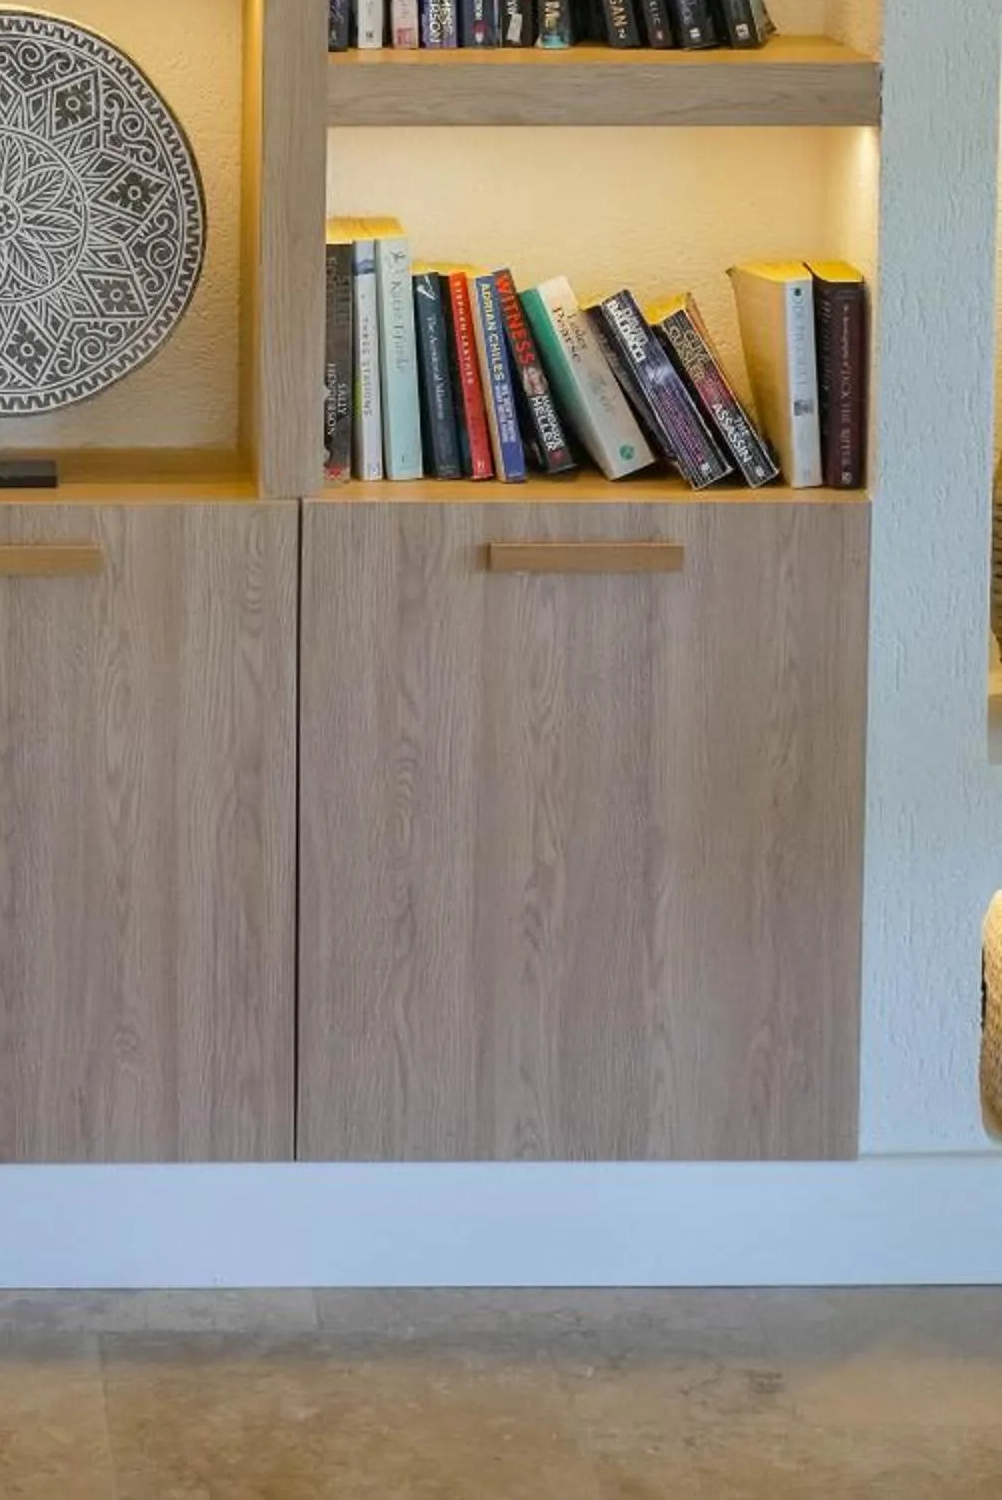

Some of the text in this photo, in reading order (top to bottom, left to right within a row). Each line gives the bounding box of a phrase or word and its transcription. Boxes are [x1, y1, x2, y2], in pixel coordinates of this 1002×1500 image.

[544, 1, 559, 29] Me
[426, 315, 438, 333] The
[453, 279, 474, 386] STEPHEN LEATHER
[479, 283, 506, 382] ADRIAN CHILES
[495, 273, 536, 366] WITNESS
[552, 306, 583, 363] Pearse
[606, 299, 647, 364] BALDACCI
[623, 306, 650, 348] DAVID
[664, 326, 705, 384] CUSSLER
[326, 362, 340, 435] HENDERSON
[336, 382, 348, 415] SALLY
[531, 396, 559, 452] HELLER
[711, 402, 753, 464] ASSASSIN
[733, 417, 750, 438] THE
